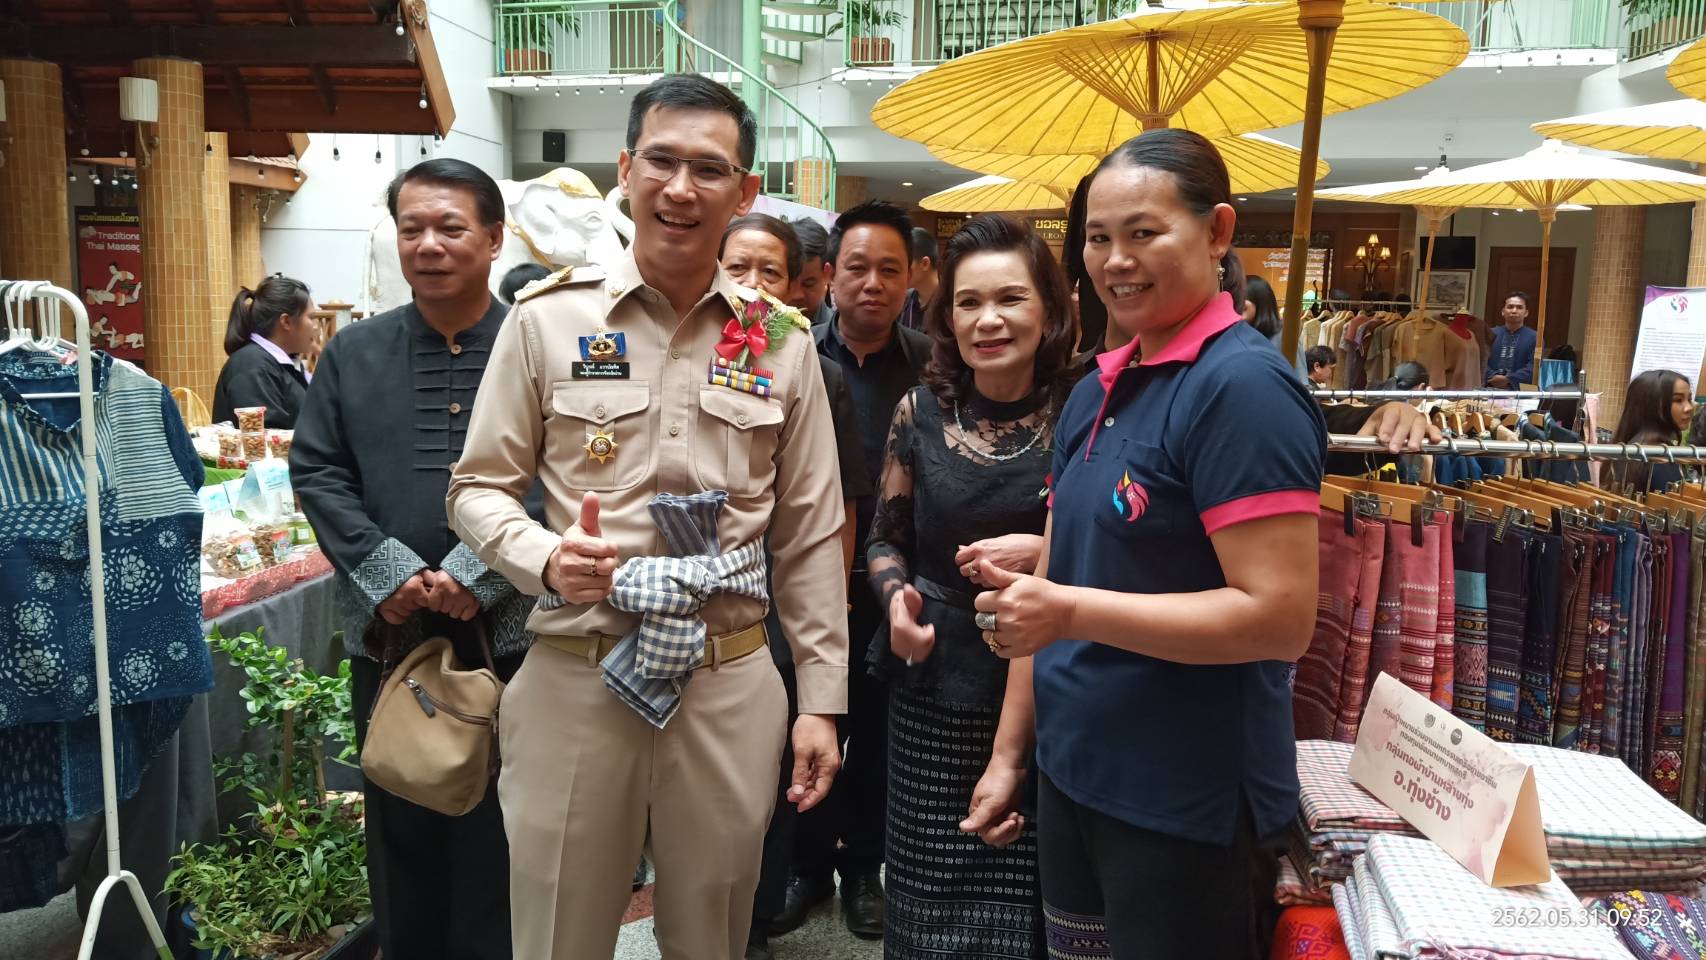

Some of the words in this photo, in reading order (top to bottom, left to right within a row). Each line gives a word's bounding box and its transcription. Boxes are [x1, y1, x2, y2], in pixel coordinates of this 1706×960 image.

[86, 241, 104, 250] Thai
[106, 243, 140, 254] Massag
[97, 231, 140, 240] Traditiona
[1385, 741, 1475, 810] กลุ่มทอผ้าบ้านหล่ายทุ่ง
[1393, 769, 1452, 821] อ.ทุ่งช้าง
